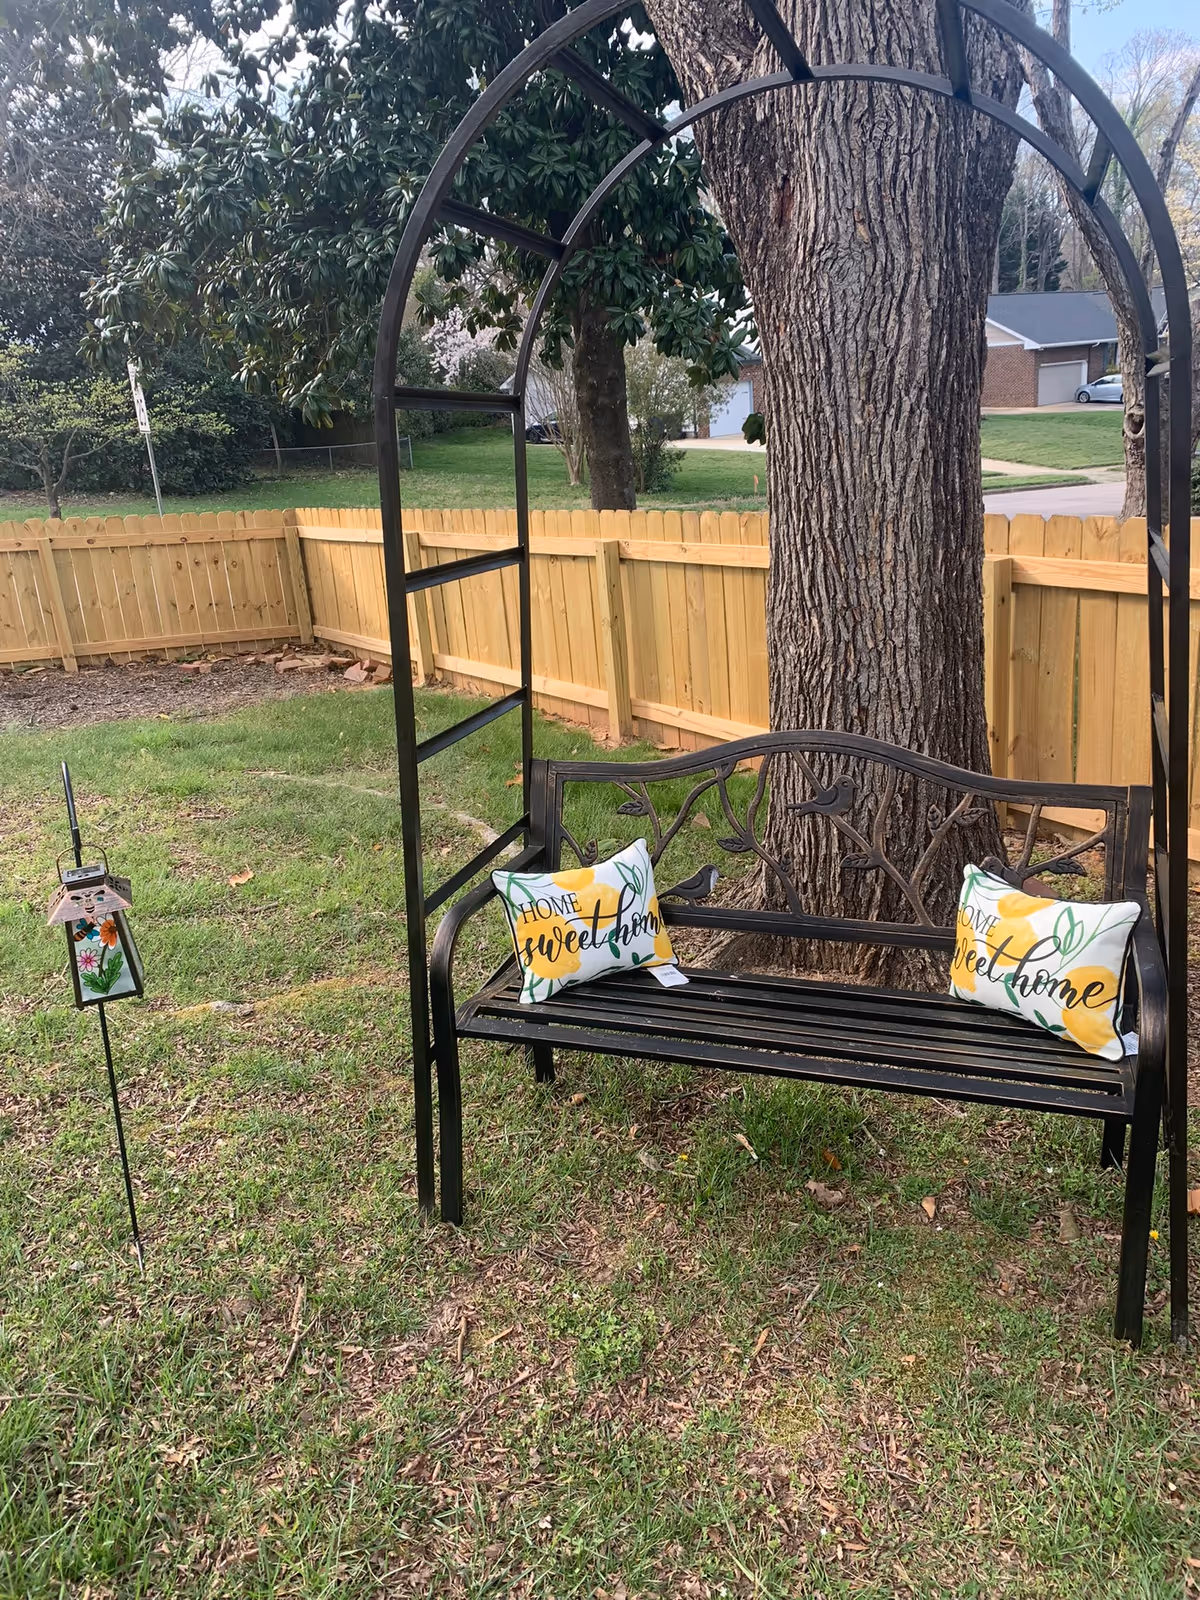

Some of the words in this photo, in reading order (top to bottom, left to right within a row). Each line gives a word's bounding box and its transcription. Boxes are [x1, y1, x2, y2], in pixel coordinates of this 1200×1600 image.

[518, 892, 582, 924] HOME
[518, 898, 608, 967] sweet
[953, 935, 1014, 983] weet
[1011, 935, 1118, 1009] home
